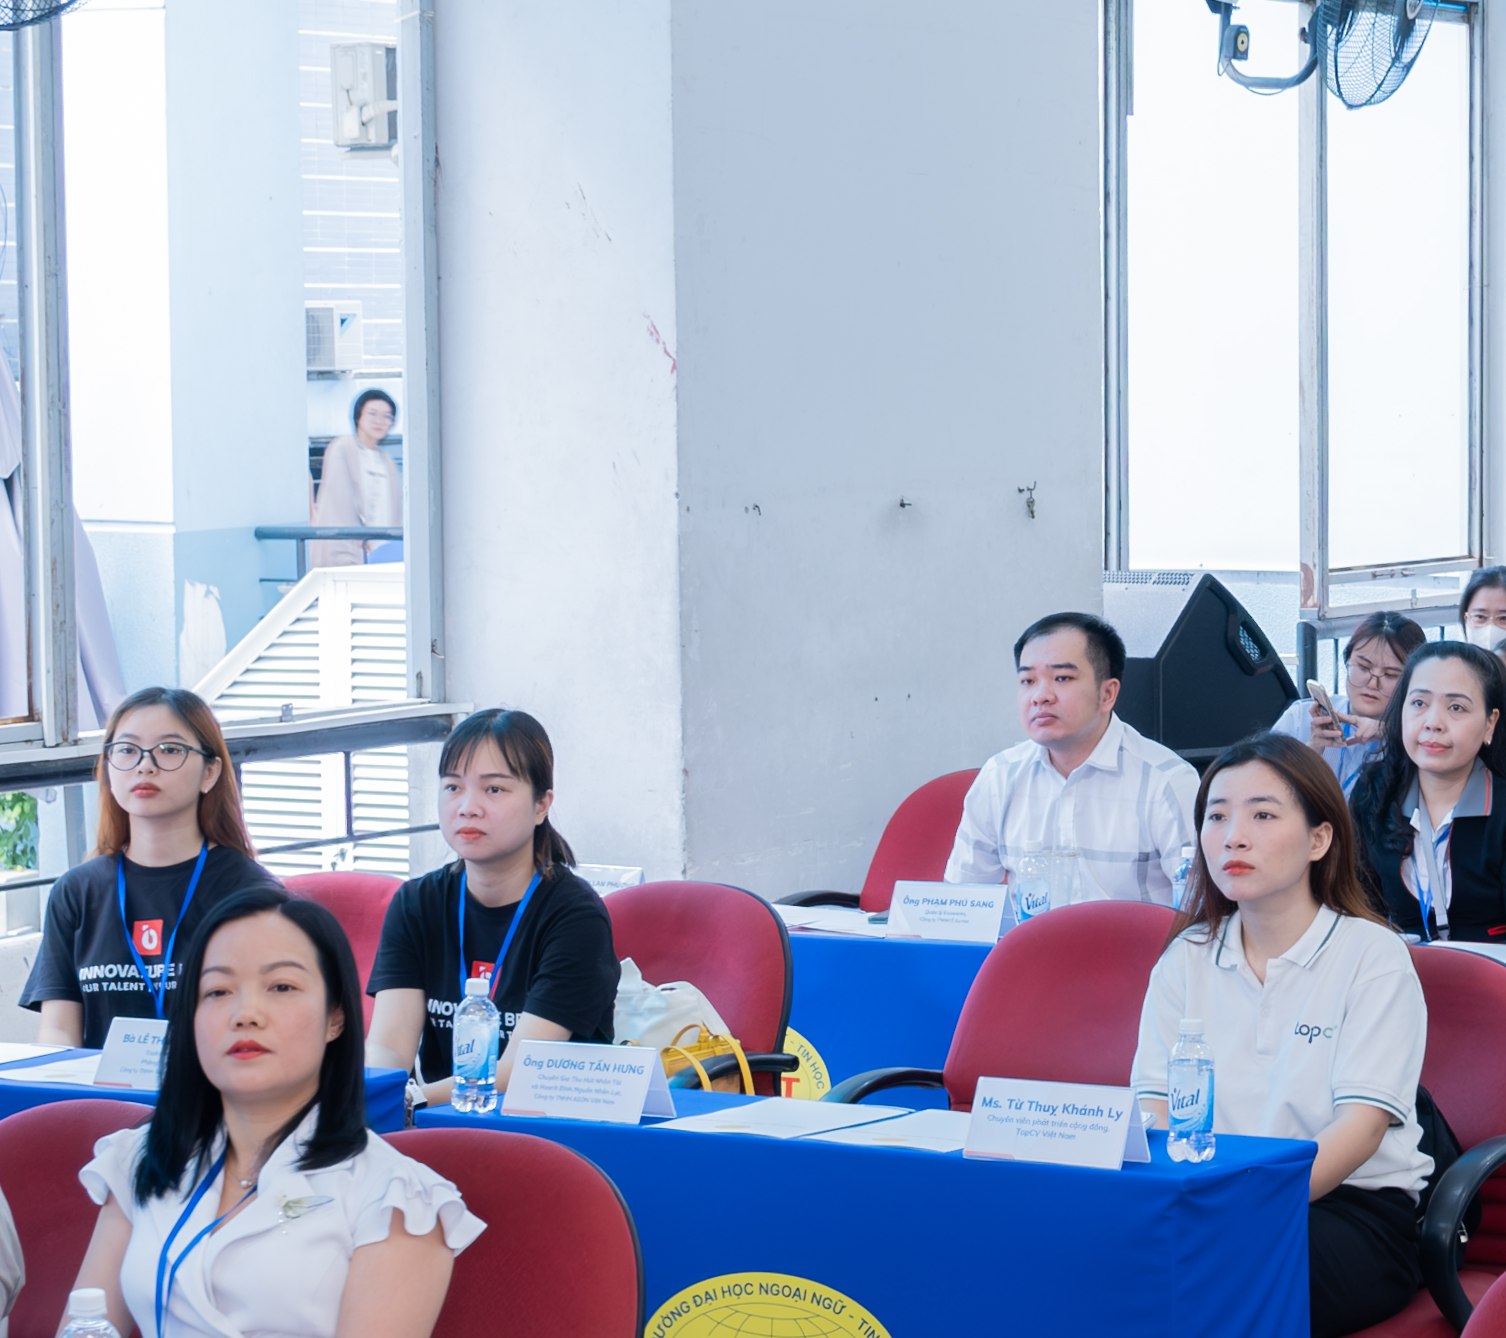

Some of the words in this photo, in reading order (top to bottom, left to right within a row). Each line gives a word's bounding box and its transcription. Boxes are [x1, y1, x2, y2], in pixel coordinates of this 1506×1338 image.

[903, 895, 919, 906] Ông
[922, 898, 947, 908] PHẠM
[970, 900, 994, 908] SANG
[523, 1057, 544, 1070] Ông
[546, 1058, 585, 1071] DƯƠNG
[588, 1060, 611, 1073] TẤN
[613, 1064, 644, 1075] HƯNG
[981, 1096, 1002, 1108] Ms.
[1007, 1098, 1024, 1110] Từ
[1027, 1100, 1059, 1116] Thuỵ
[1062, 1103, 1103, 1118] Khánh
[1108, 1107, 1124, 1122] Ly
[1016, 1128, 1040, 1137] TopCV
[1059, 1131, 1076, 1139] Nam
